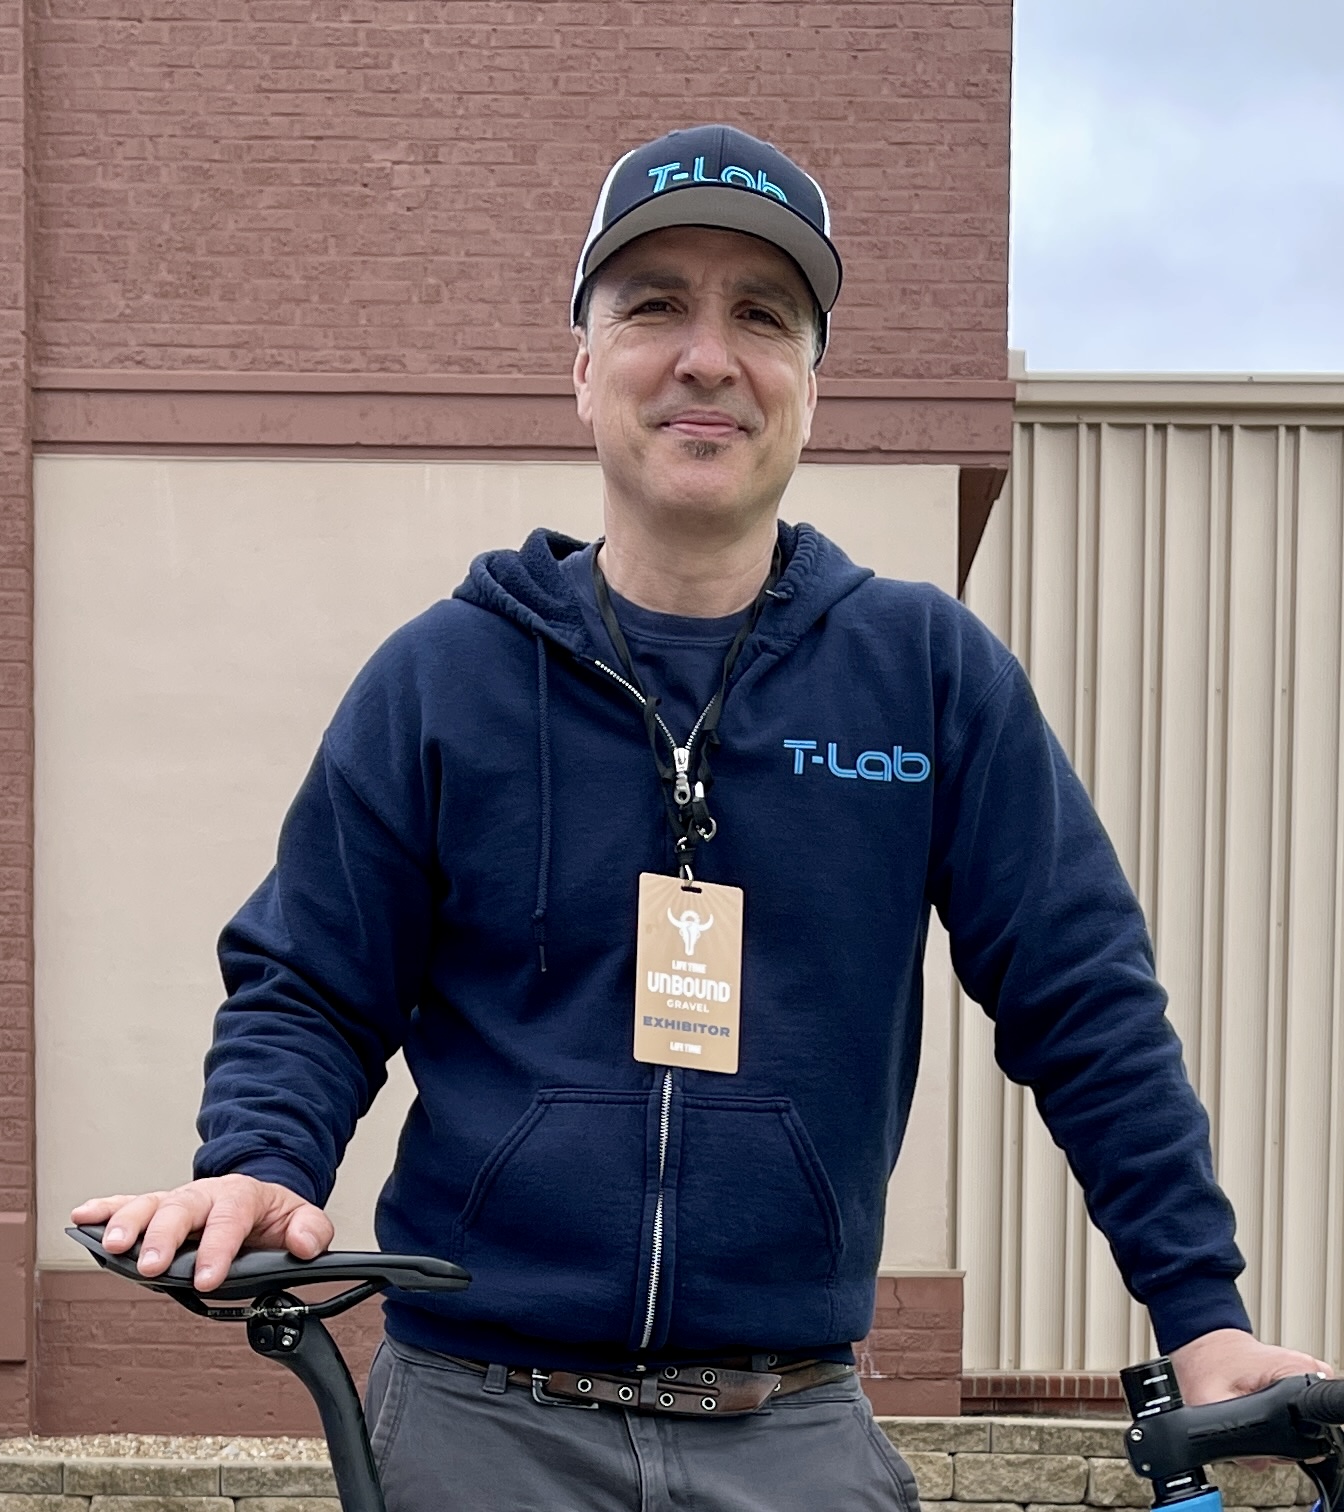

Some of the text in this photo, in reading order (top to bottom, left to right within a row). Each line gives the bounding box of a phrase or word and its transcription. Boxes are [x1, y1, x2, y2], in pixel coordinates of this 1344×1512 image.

[783, 738, 931, 783] T-Lab
[647, 971, 731, 1003] UNBOUND
[666, 999, 710, 1014] GRAVEL
[643, 1015, 731, 1038] EXHIBITOR
